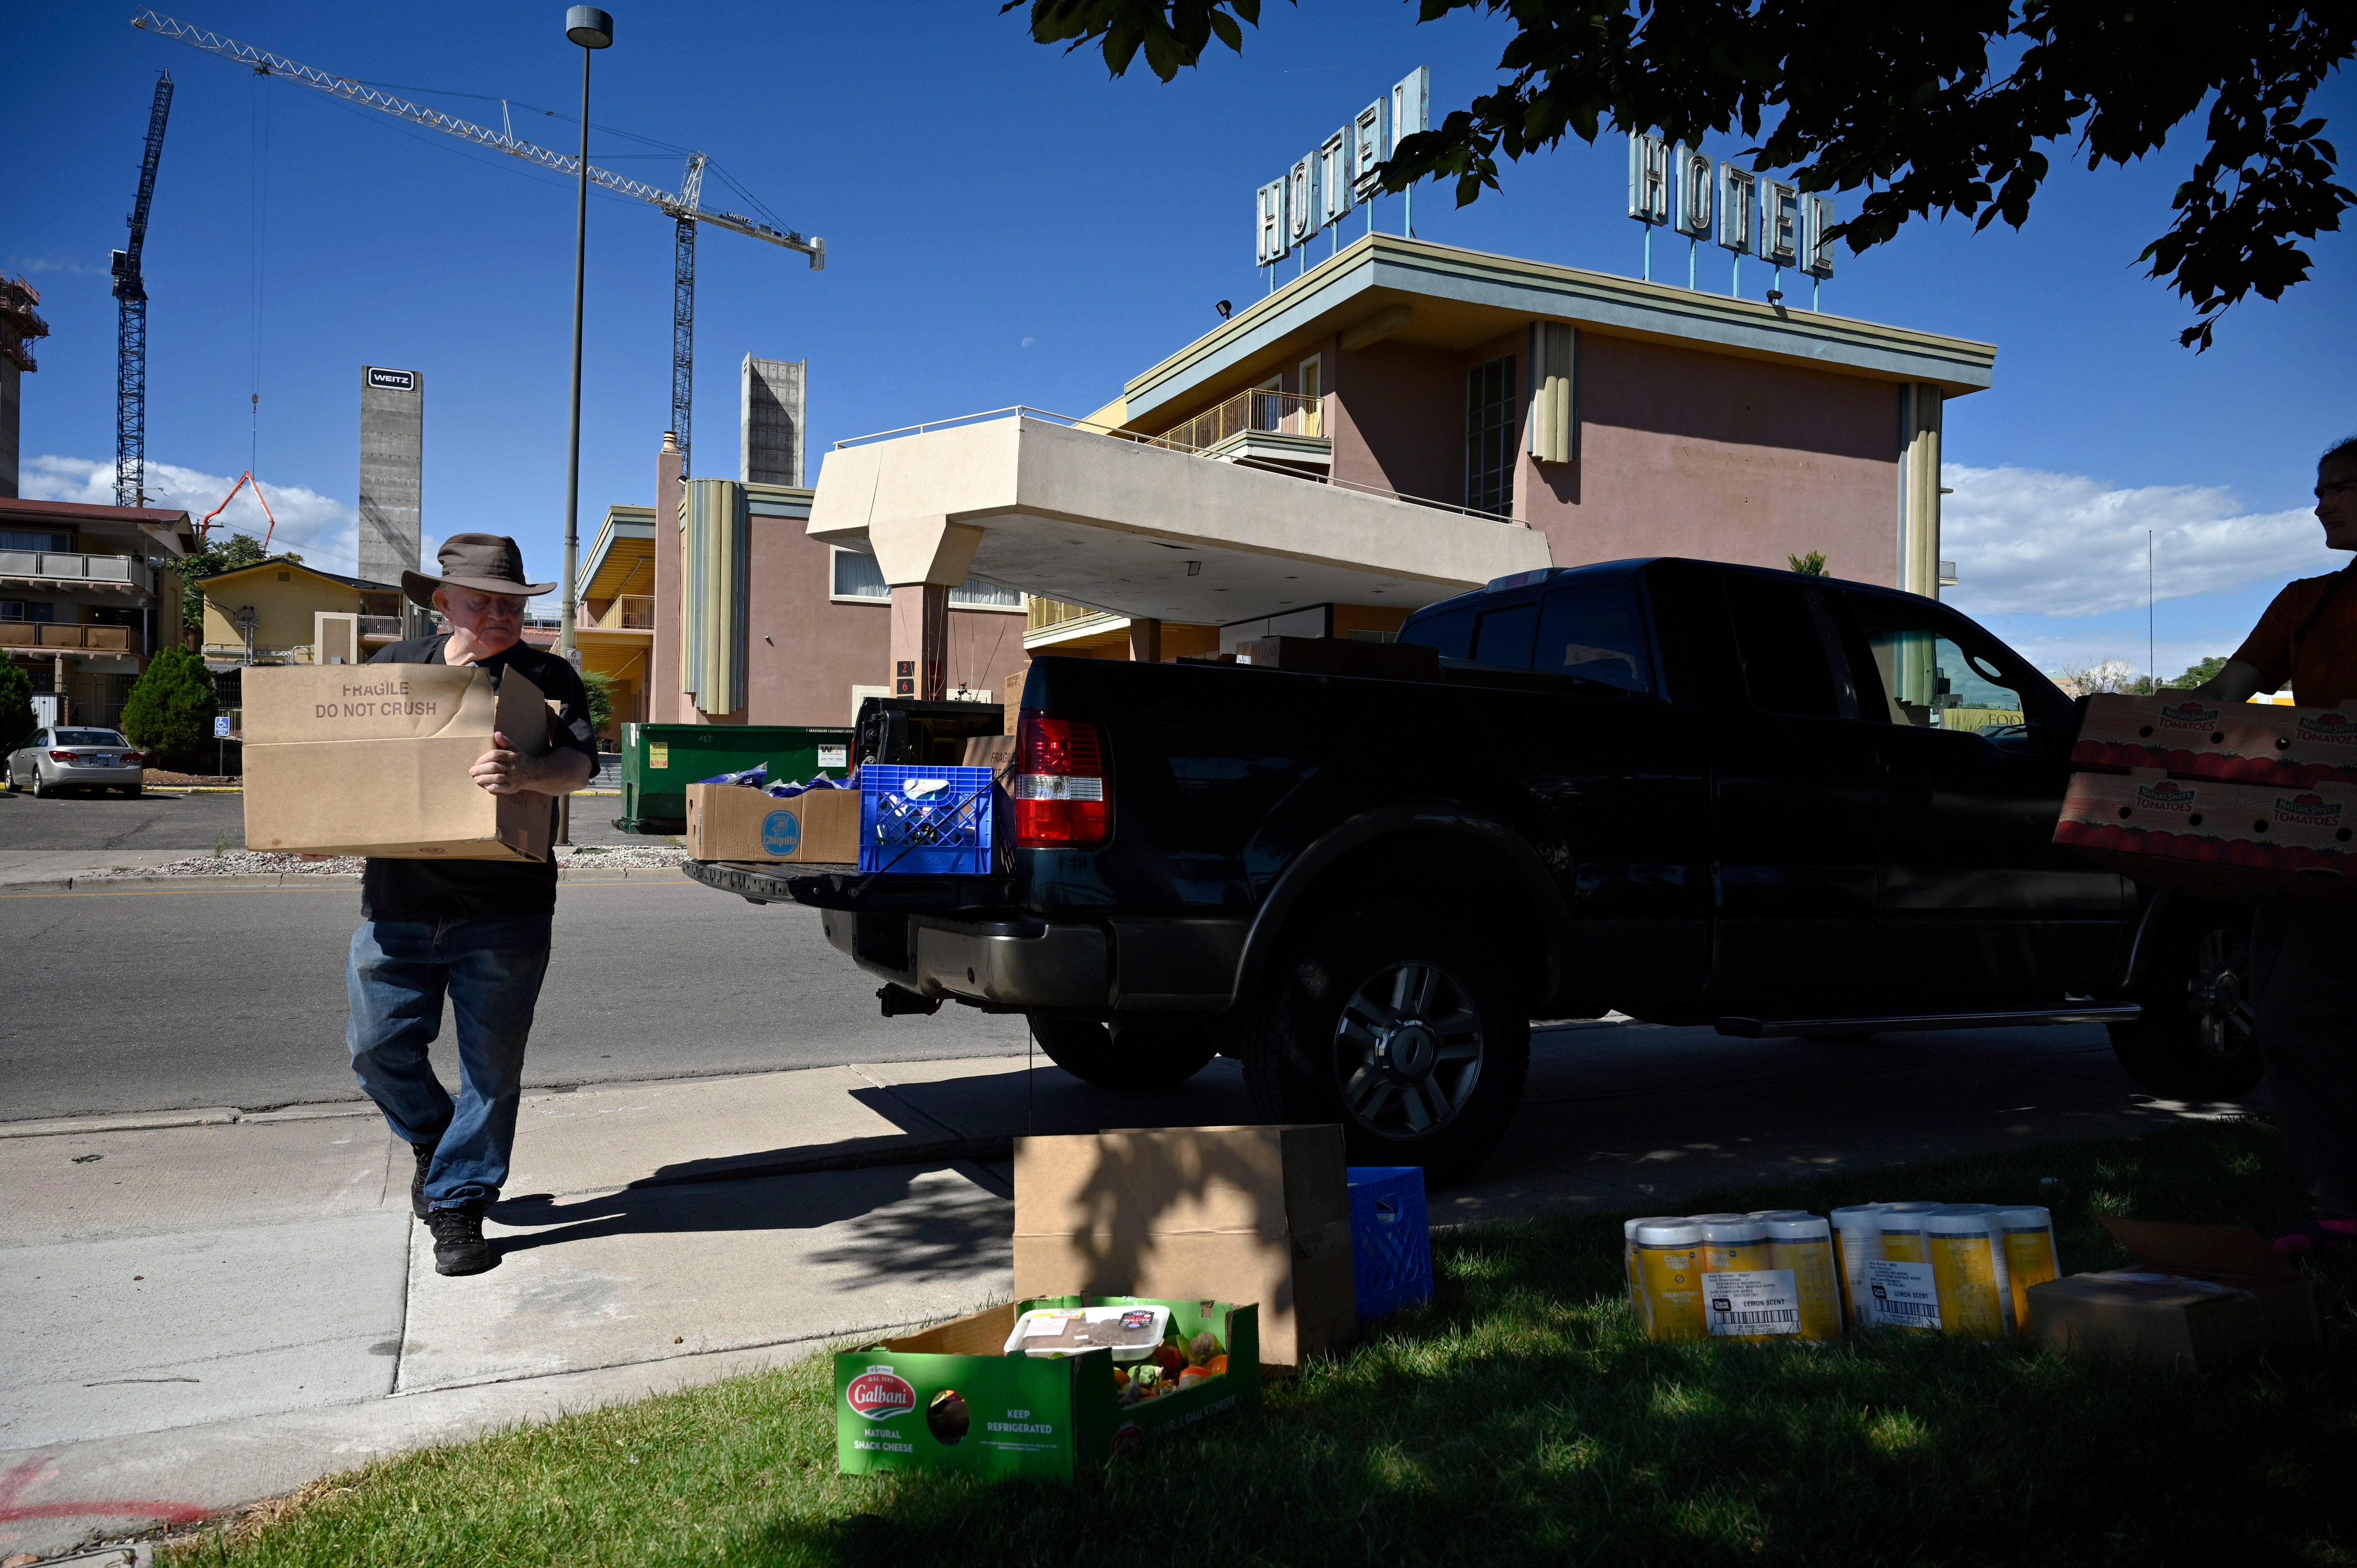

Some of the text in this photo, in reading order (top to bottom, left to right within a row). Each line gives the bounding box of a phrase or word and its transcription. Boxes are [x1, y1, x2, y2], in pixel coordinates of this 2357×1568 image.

[1635, 132, 1832, 275] HOTEL
[728, 211, 753, 224] WEITZ
[374, 374, 410, 384] WEITZ
[902, 663, 907, 673] 2
[343, 682, 409, 696] FRAGILE
[902, 681, 908, 691] 6
[316, 702, 436, 718] DO NOT CRUSH
[1987, 714, 2023, 725] FOO
[2159, 717, 2216, 731] TOMATOES
[2302, 719, 2357, 733] NATURESWEE
[991, 752, 1012, 763] FRAGIL
[2137, 796, 2193, 812] TOMATOES
[2274, 809, 2339, 826] TOMATOES
[763, 834, 797, 847] Chiquita
[854, 1384, 907, 1404] Galbani
[1007, 1409, 1030, 1419] KEEP
[864, 1429, 901, 1439] NATURAL
[987, 1421, 1052, 1434] REFRIGERATED
[854, 1440, 913, 1453] SNACK CHEESE
